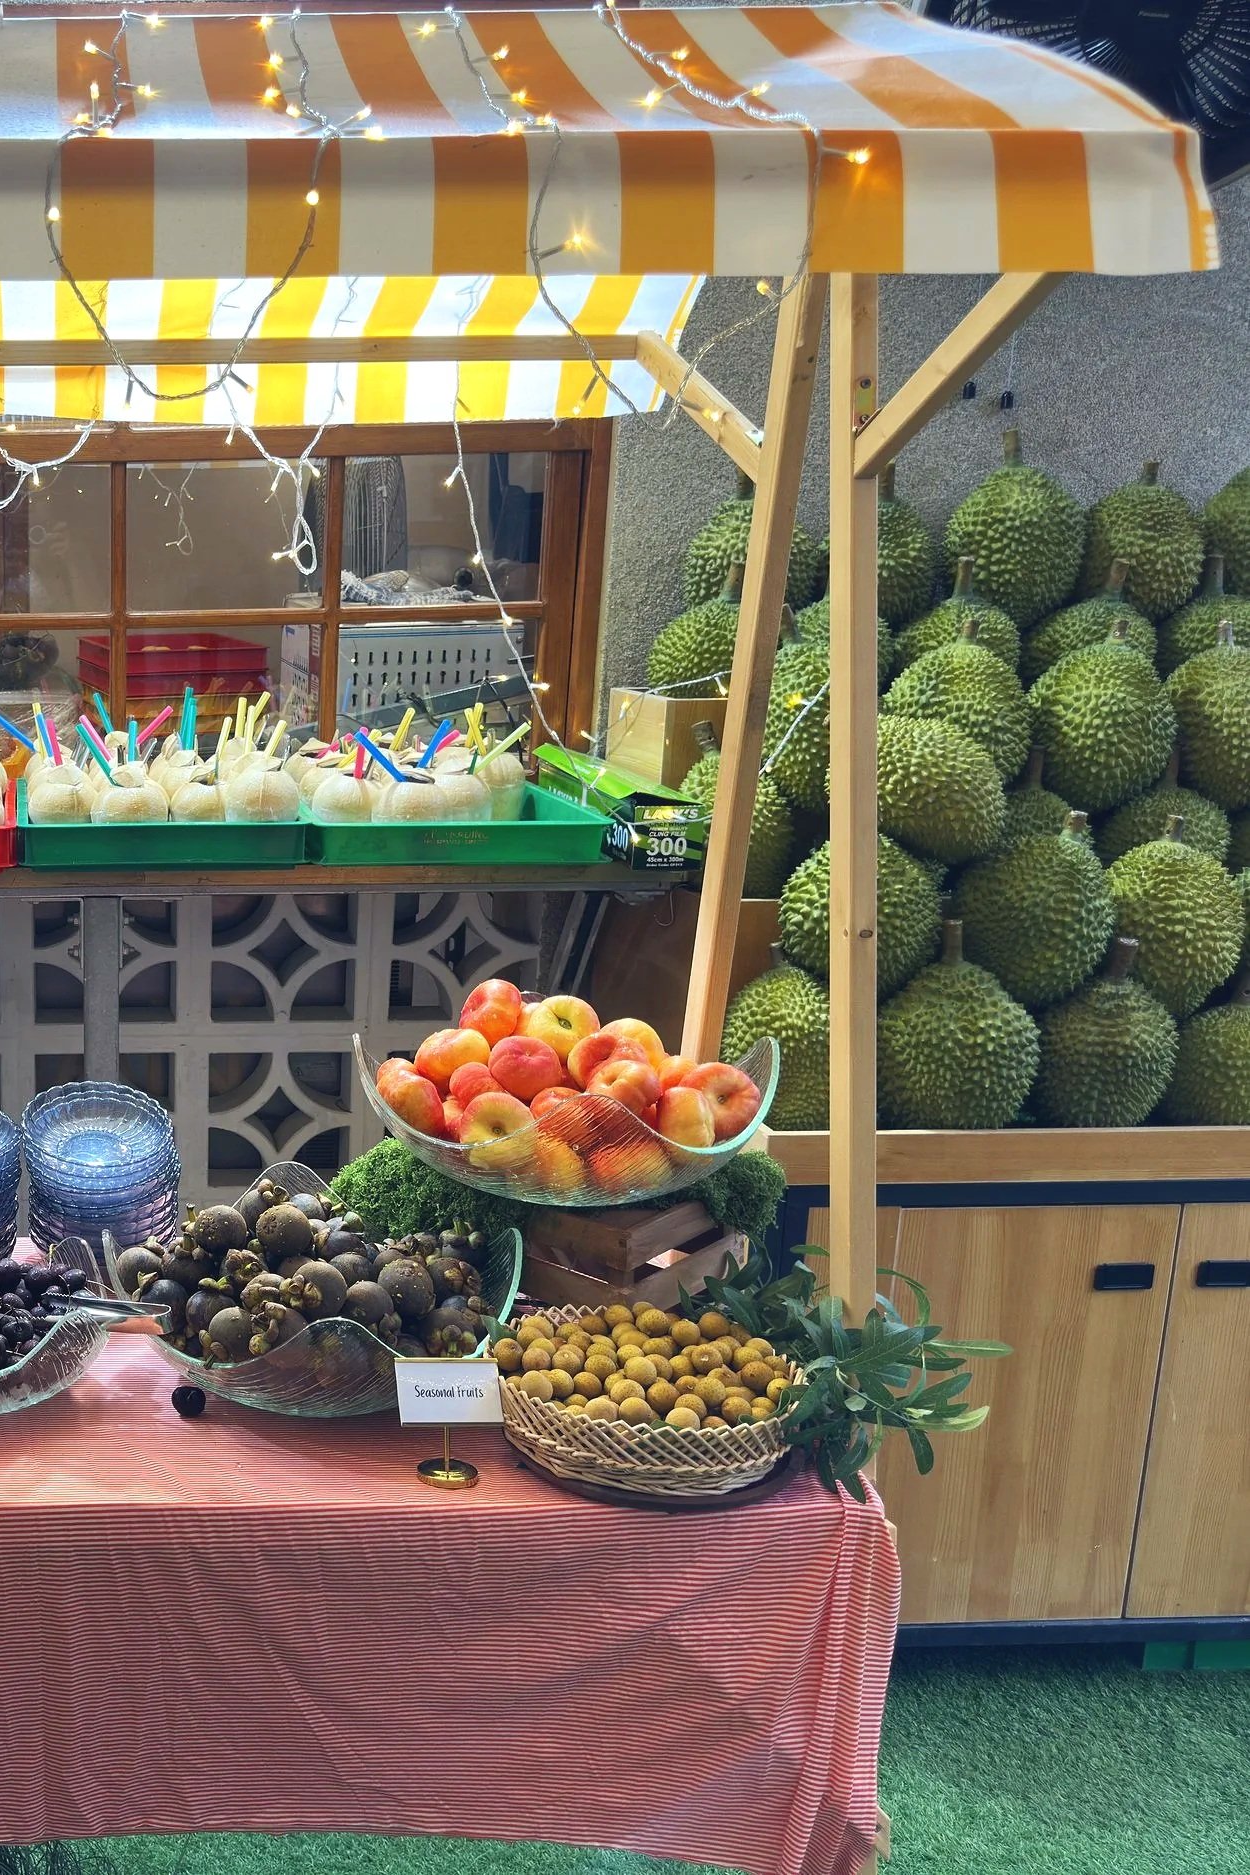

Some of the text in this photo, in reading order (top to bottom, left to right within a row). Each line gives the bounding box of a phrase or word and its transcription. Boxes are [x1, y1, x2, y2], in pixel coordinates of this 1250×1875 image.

[612, 823, 629, 852] 300
[646, 837, 687, 856] 300
[414, 1384, 455, 1398] Seasonal
